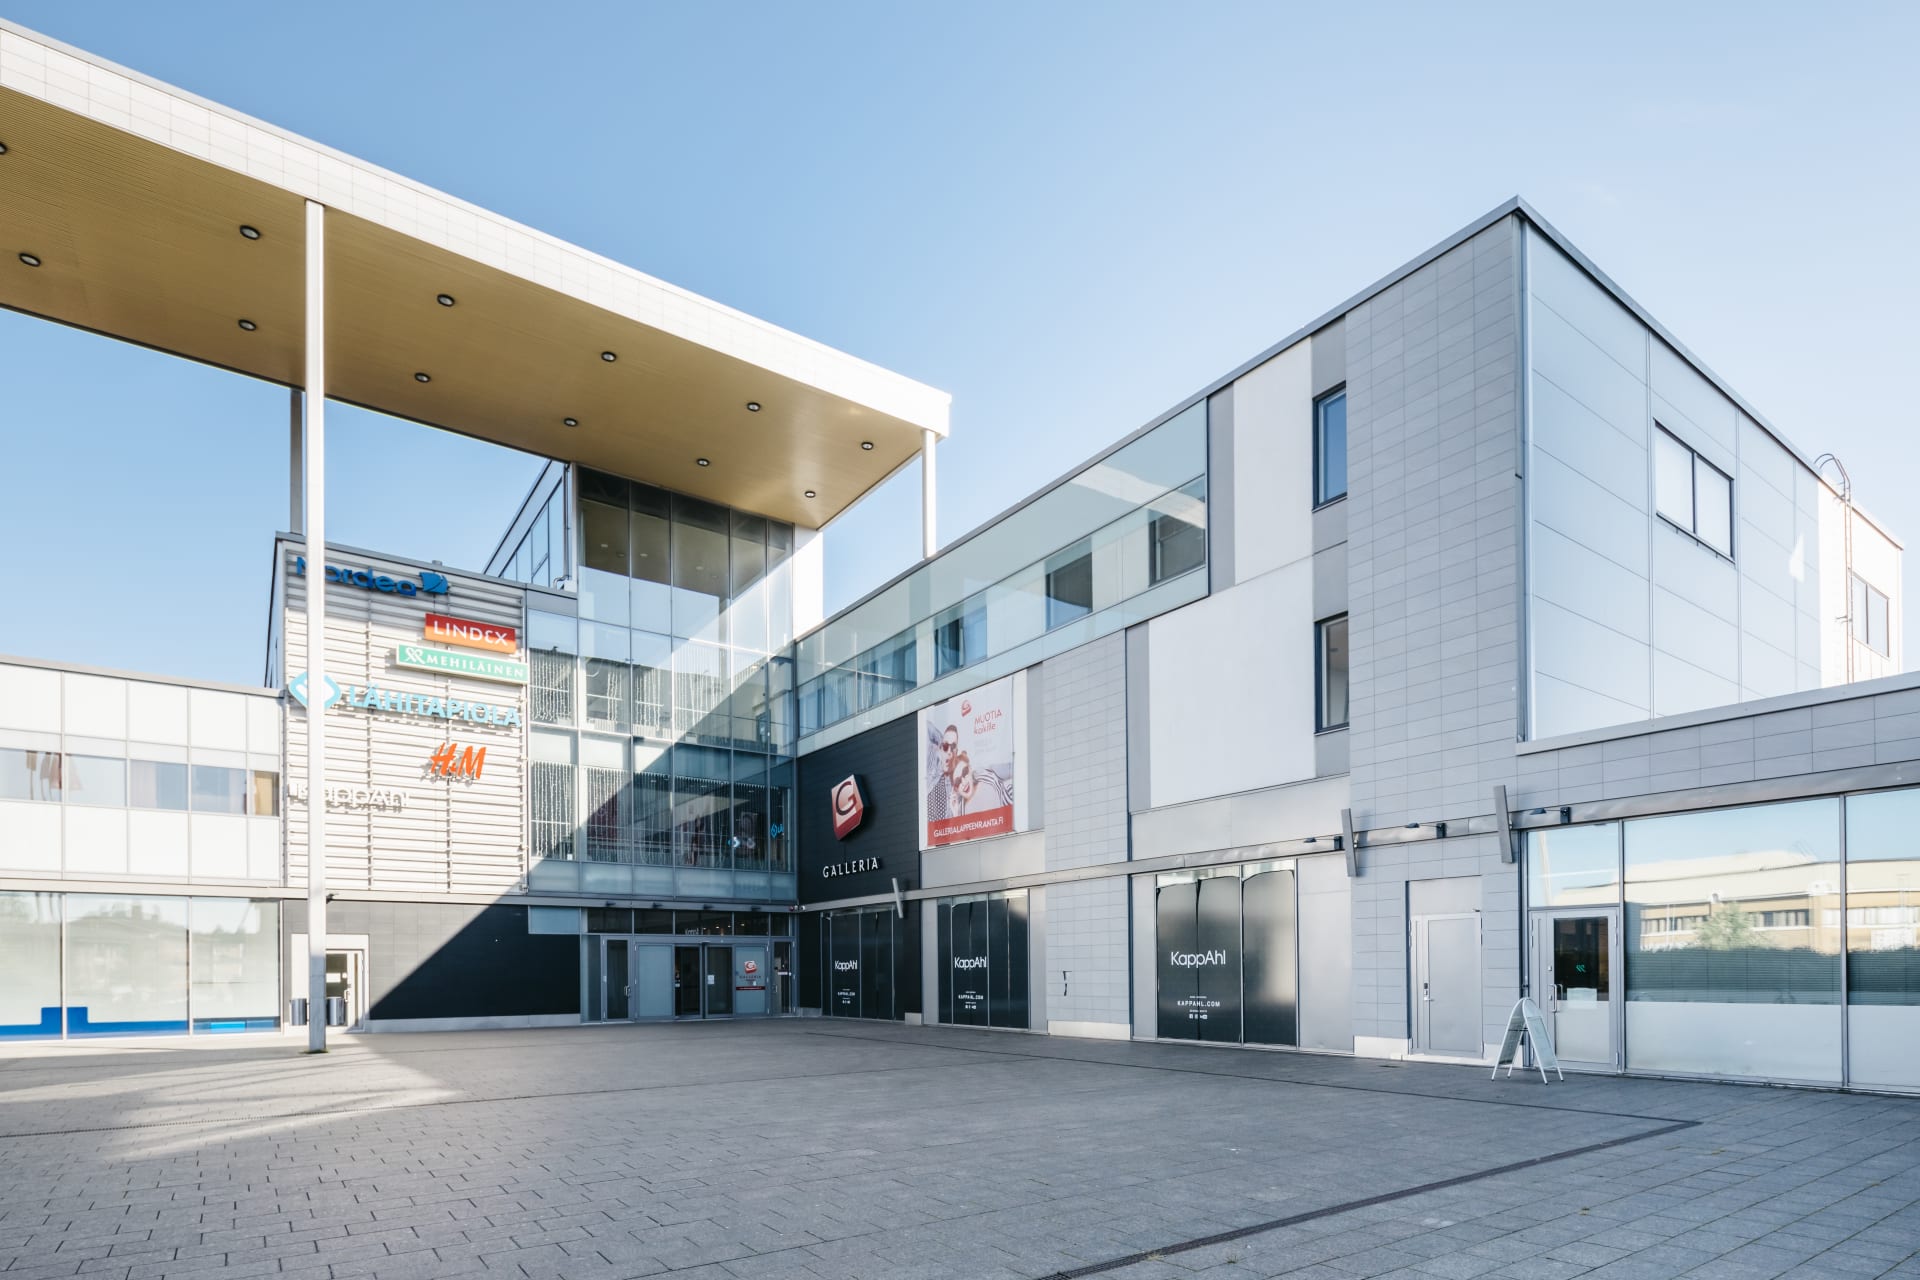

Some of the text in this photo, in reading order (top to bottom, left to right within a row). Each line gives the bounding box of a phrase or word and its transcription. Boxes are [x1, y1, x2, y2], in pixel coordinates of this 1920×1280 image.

[433, 620, 509, 647] LINDEX
[426, 653, 524, 678] MEHILÄINEN
[349, 681, 522, 729] LÄHITAPIOLA
[430, 742, 487, 780] H&M
[933, 816, 1005, 838] GALLERIALAPPEENRANTA.FI
[822, 856, 880, 878] GALLERIA
[834, 959, 858, 972] KappAhl
[954, 956, 987, 971] KappAhl
[1171, 949, 1226, 969] KappAhl
